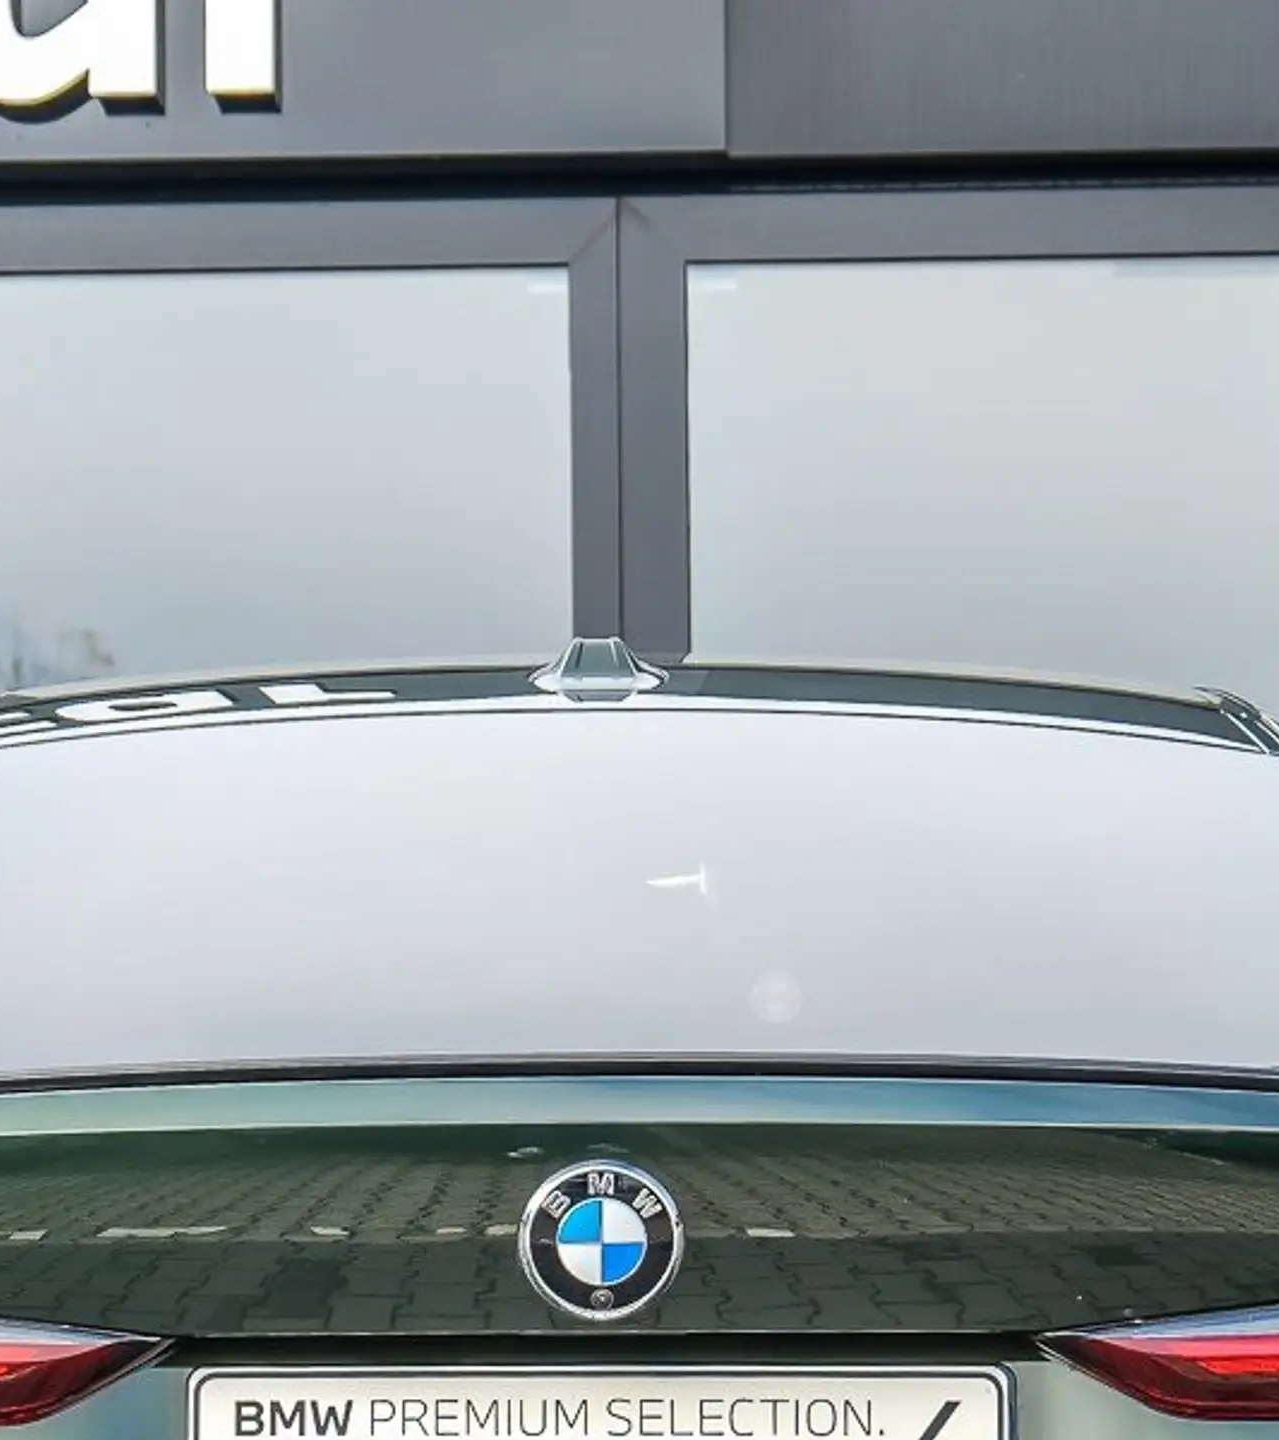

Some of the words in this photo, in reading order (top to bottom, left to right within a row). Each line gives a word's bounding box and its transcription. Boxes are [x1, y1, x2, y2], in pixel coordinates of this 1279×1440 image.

[540, 1172, 663, 1220] BMW
[234, 1399, 354, 1437] BMW
[370, 1399, 589, 1437] PREMIUM
[606, 1398, 885, 1437] SELECTION.
